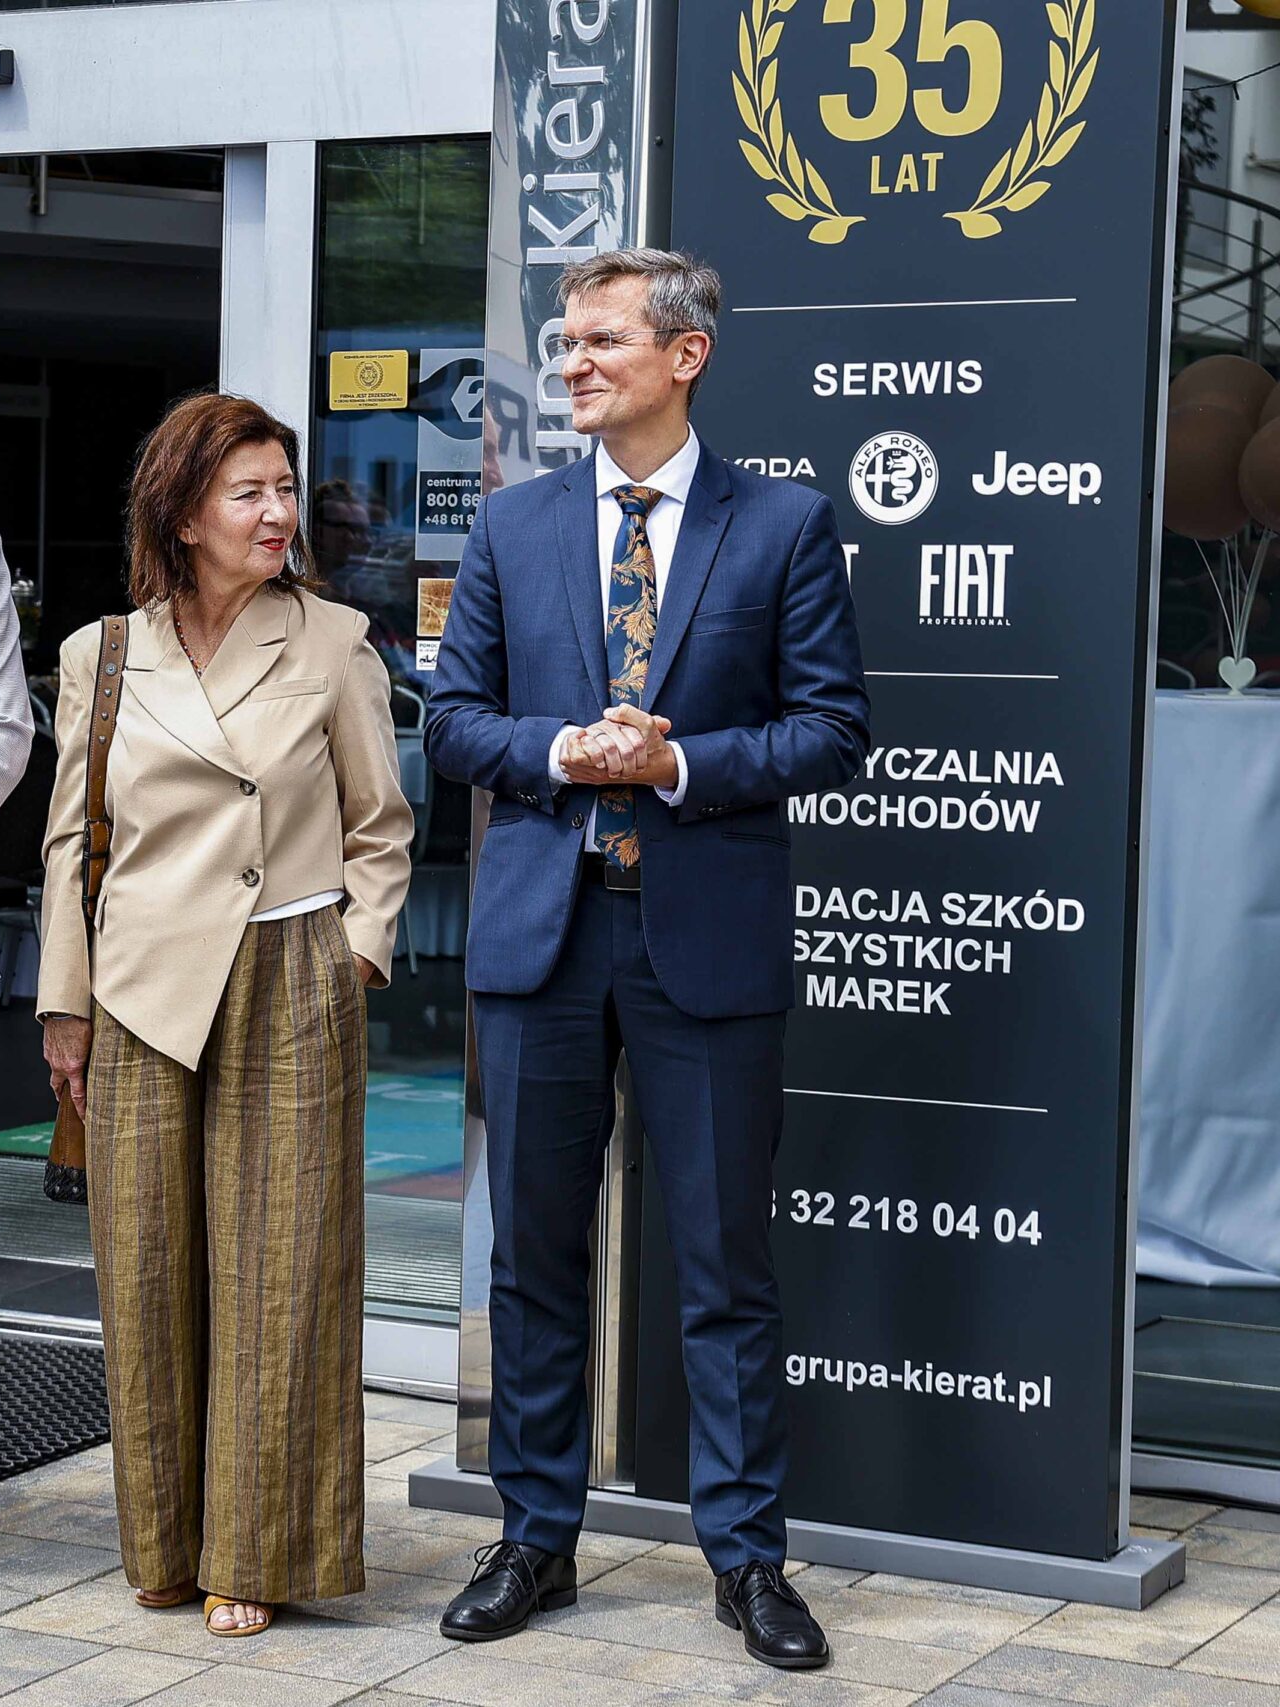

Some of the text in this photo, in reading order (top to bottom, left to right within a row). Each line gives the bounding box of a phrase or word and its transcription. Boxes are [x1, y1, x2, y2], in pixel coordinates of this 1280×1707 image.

[819, 0, 1003, 142] 35
[870, 152, 944, 194] LAT
[812, 359, 983, 397] SERWIS
[723, 457, 817, 478] ODA
[855, 436, 933, 479] ALFA ROMEO
[971, 450, 1102, 505] Jeep
[426, 477, 472, 487] centrum
[426, 492, 458, 508] 800
[424, 513, 448, 526] +48
[450, 513, 464, 525] 61
[920, 544, 1014, 618] FIAT
[919, 617, 1012, 626] PROFESSIONAL
[940, 888, 1085, 932] SZKÓD
[806, 974, 952, 1016] MAREK
[790, 1189, 835, 1226] 32
[847, 1194, 919, 1234] 218
[932, 1202, 980, 1240] 04
[993, 1207, 1043, 1246] 04
[785, 1353, 1052, 1413] grupa-kierat.pl
